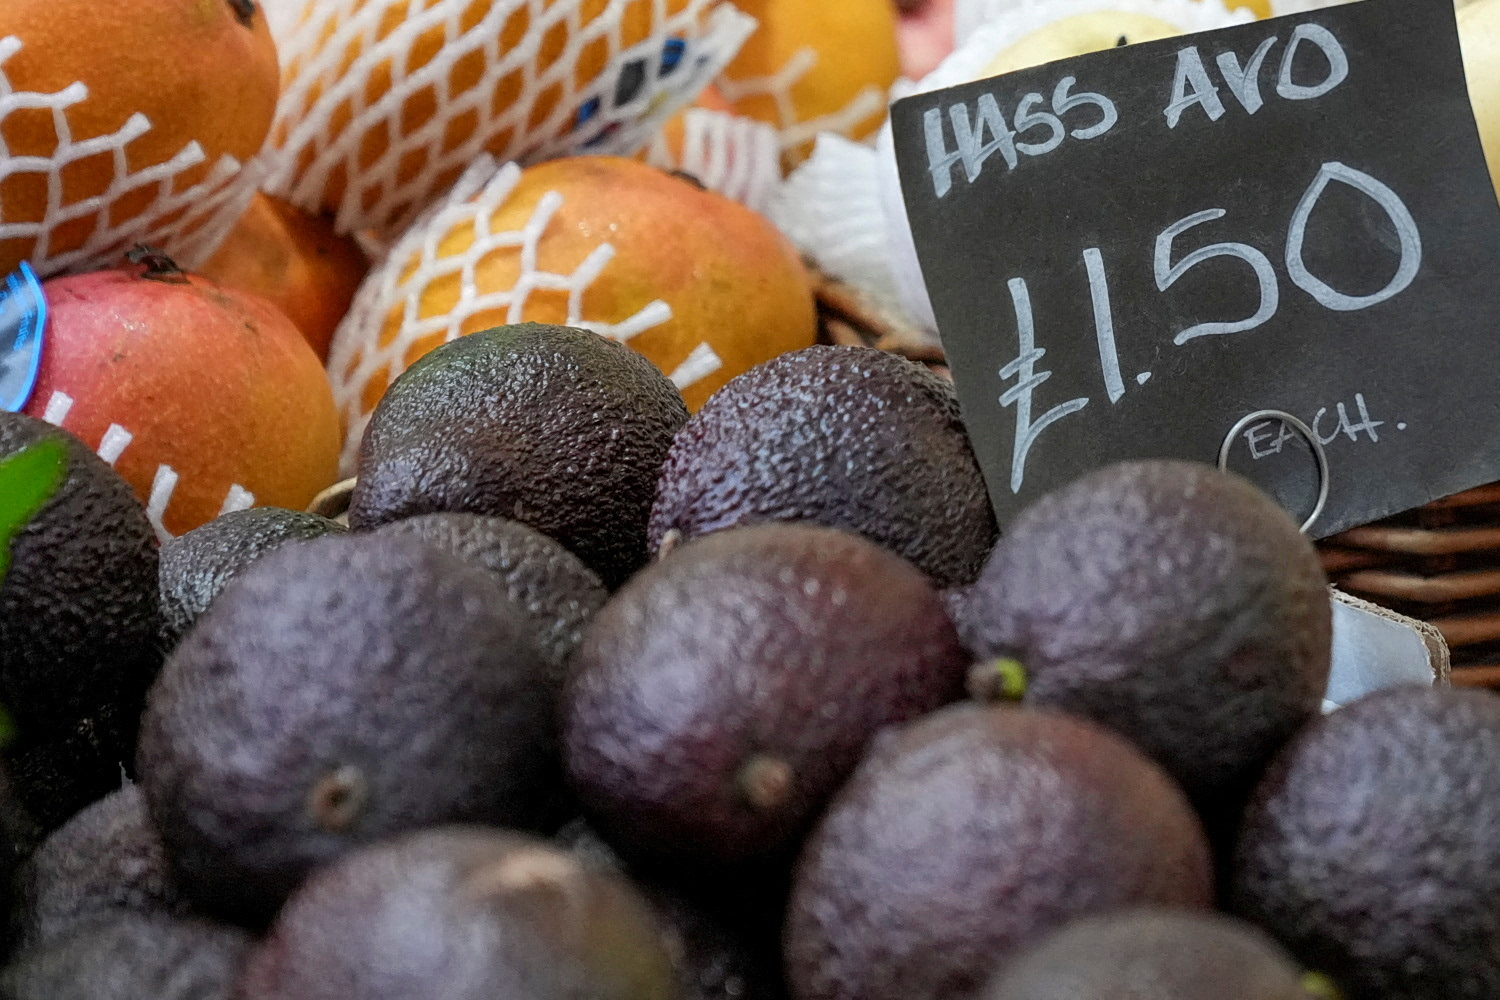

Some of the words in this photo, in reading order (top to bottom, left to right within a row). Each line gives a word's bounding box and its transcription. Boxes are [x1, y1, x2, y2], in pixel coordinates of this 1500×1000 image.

[922, 76, 1119, 198] HASS
[1164, 22, 1349, 129] AVO
[998, 160, 1422, 494] £1.50
